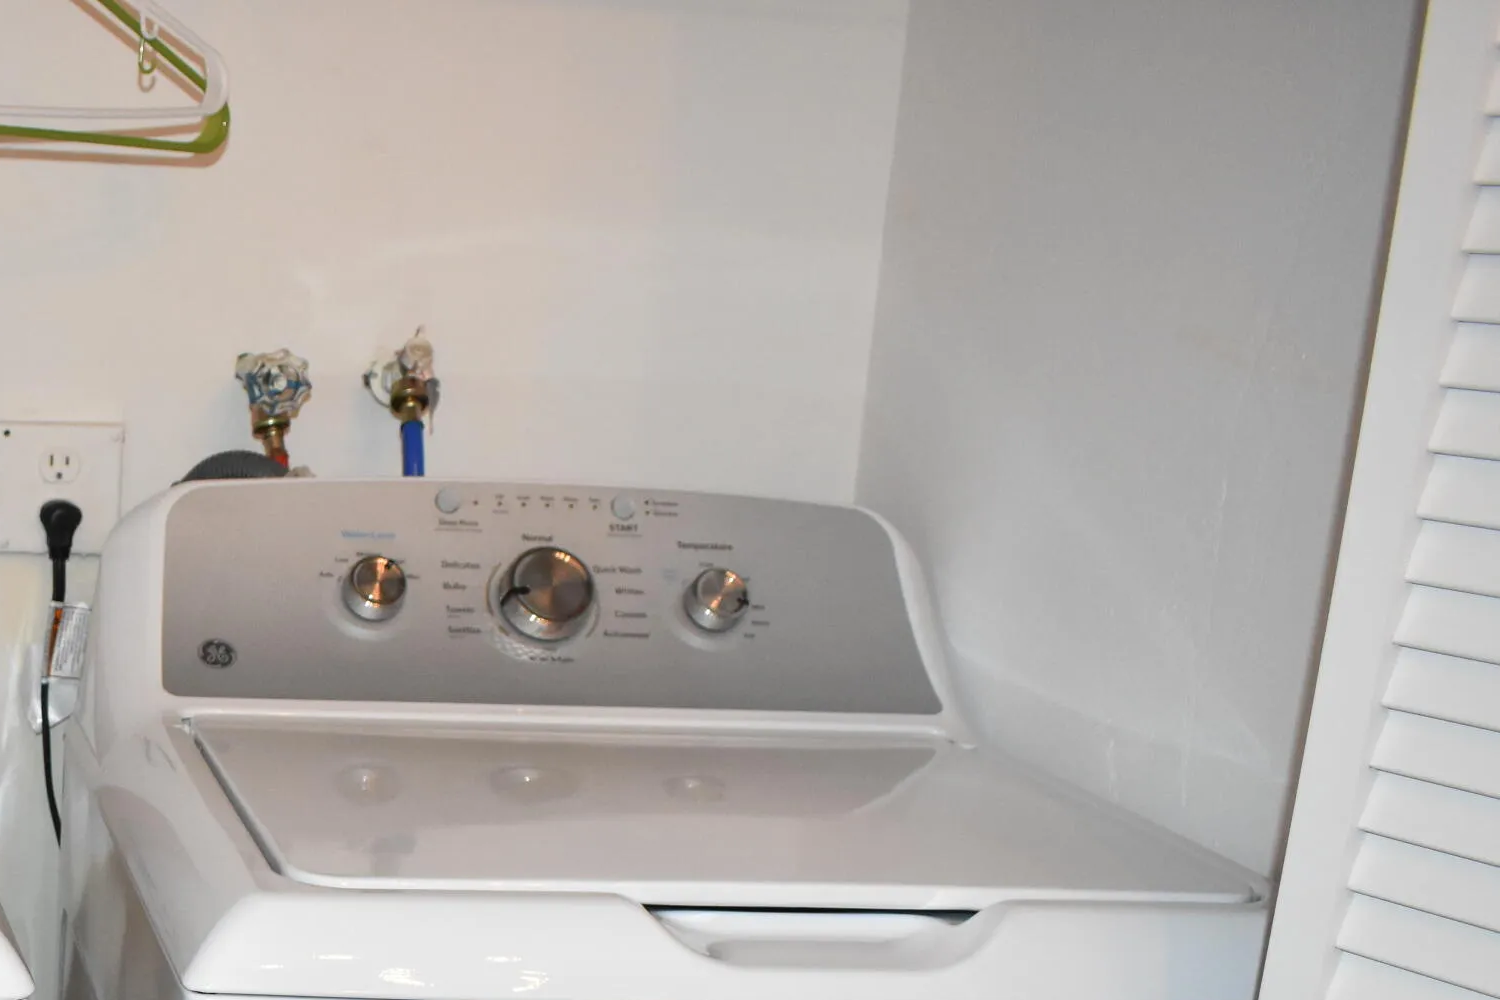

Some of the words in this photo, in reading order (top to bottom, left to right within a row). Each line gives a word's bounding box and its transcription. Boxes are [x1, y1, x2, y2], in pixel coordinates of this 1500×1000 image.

[608, 523, 639, 532] START
[521, 533, 553, 541] Normal
[677, 541, 734, 551] Temperature
